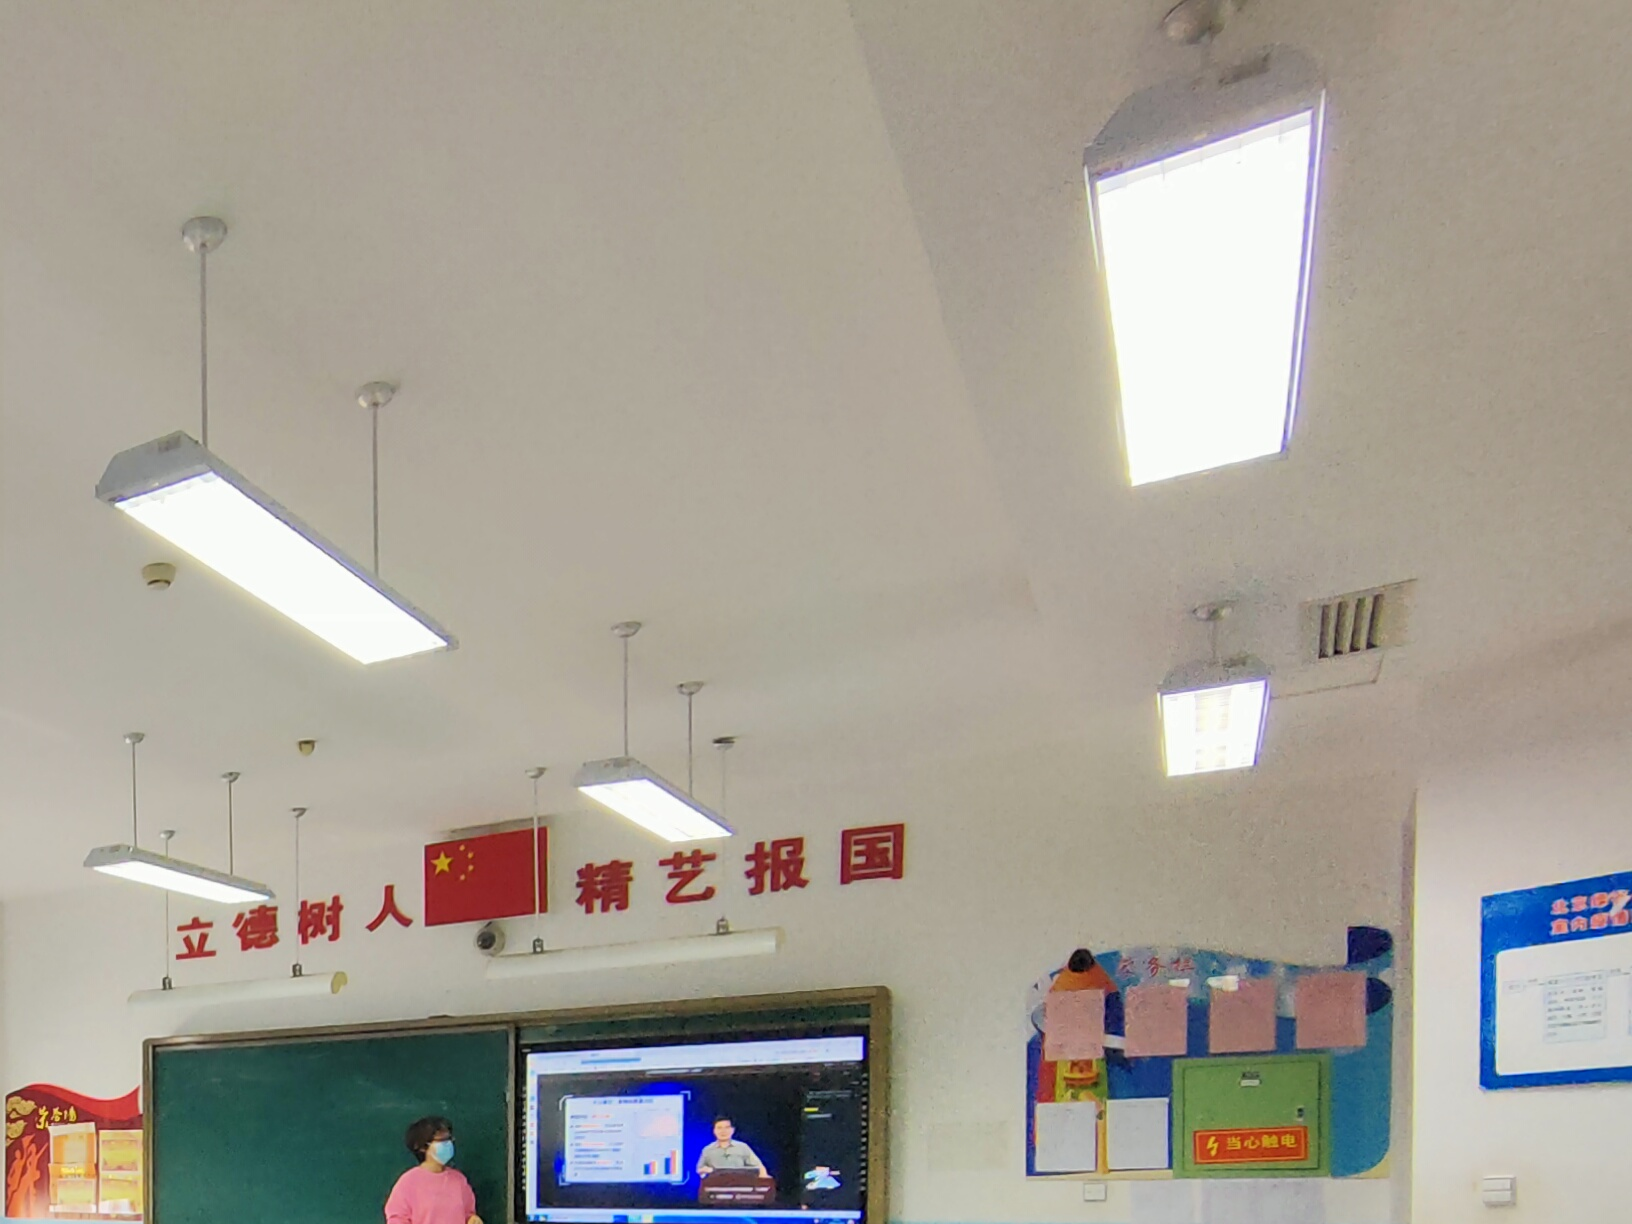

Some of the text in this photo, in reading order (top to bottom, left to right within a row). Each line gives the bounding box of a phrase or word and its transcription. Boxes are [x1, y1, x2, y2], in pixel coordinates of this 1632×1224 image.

[175, 823, 905, 961] 立德树人 精艺报国
[1226, 1133, 1297, 1151] 当心触电
